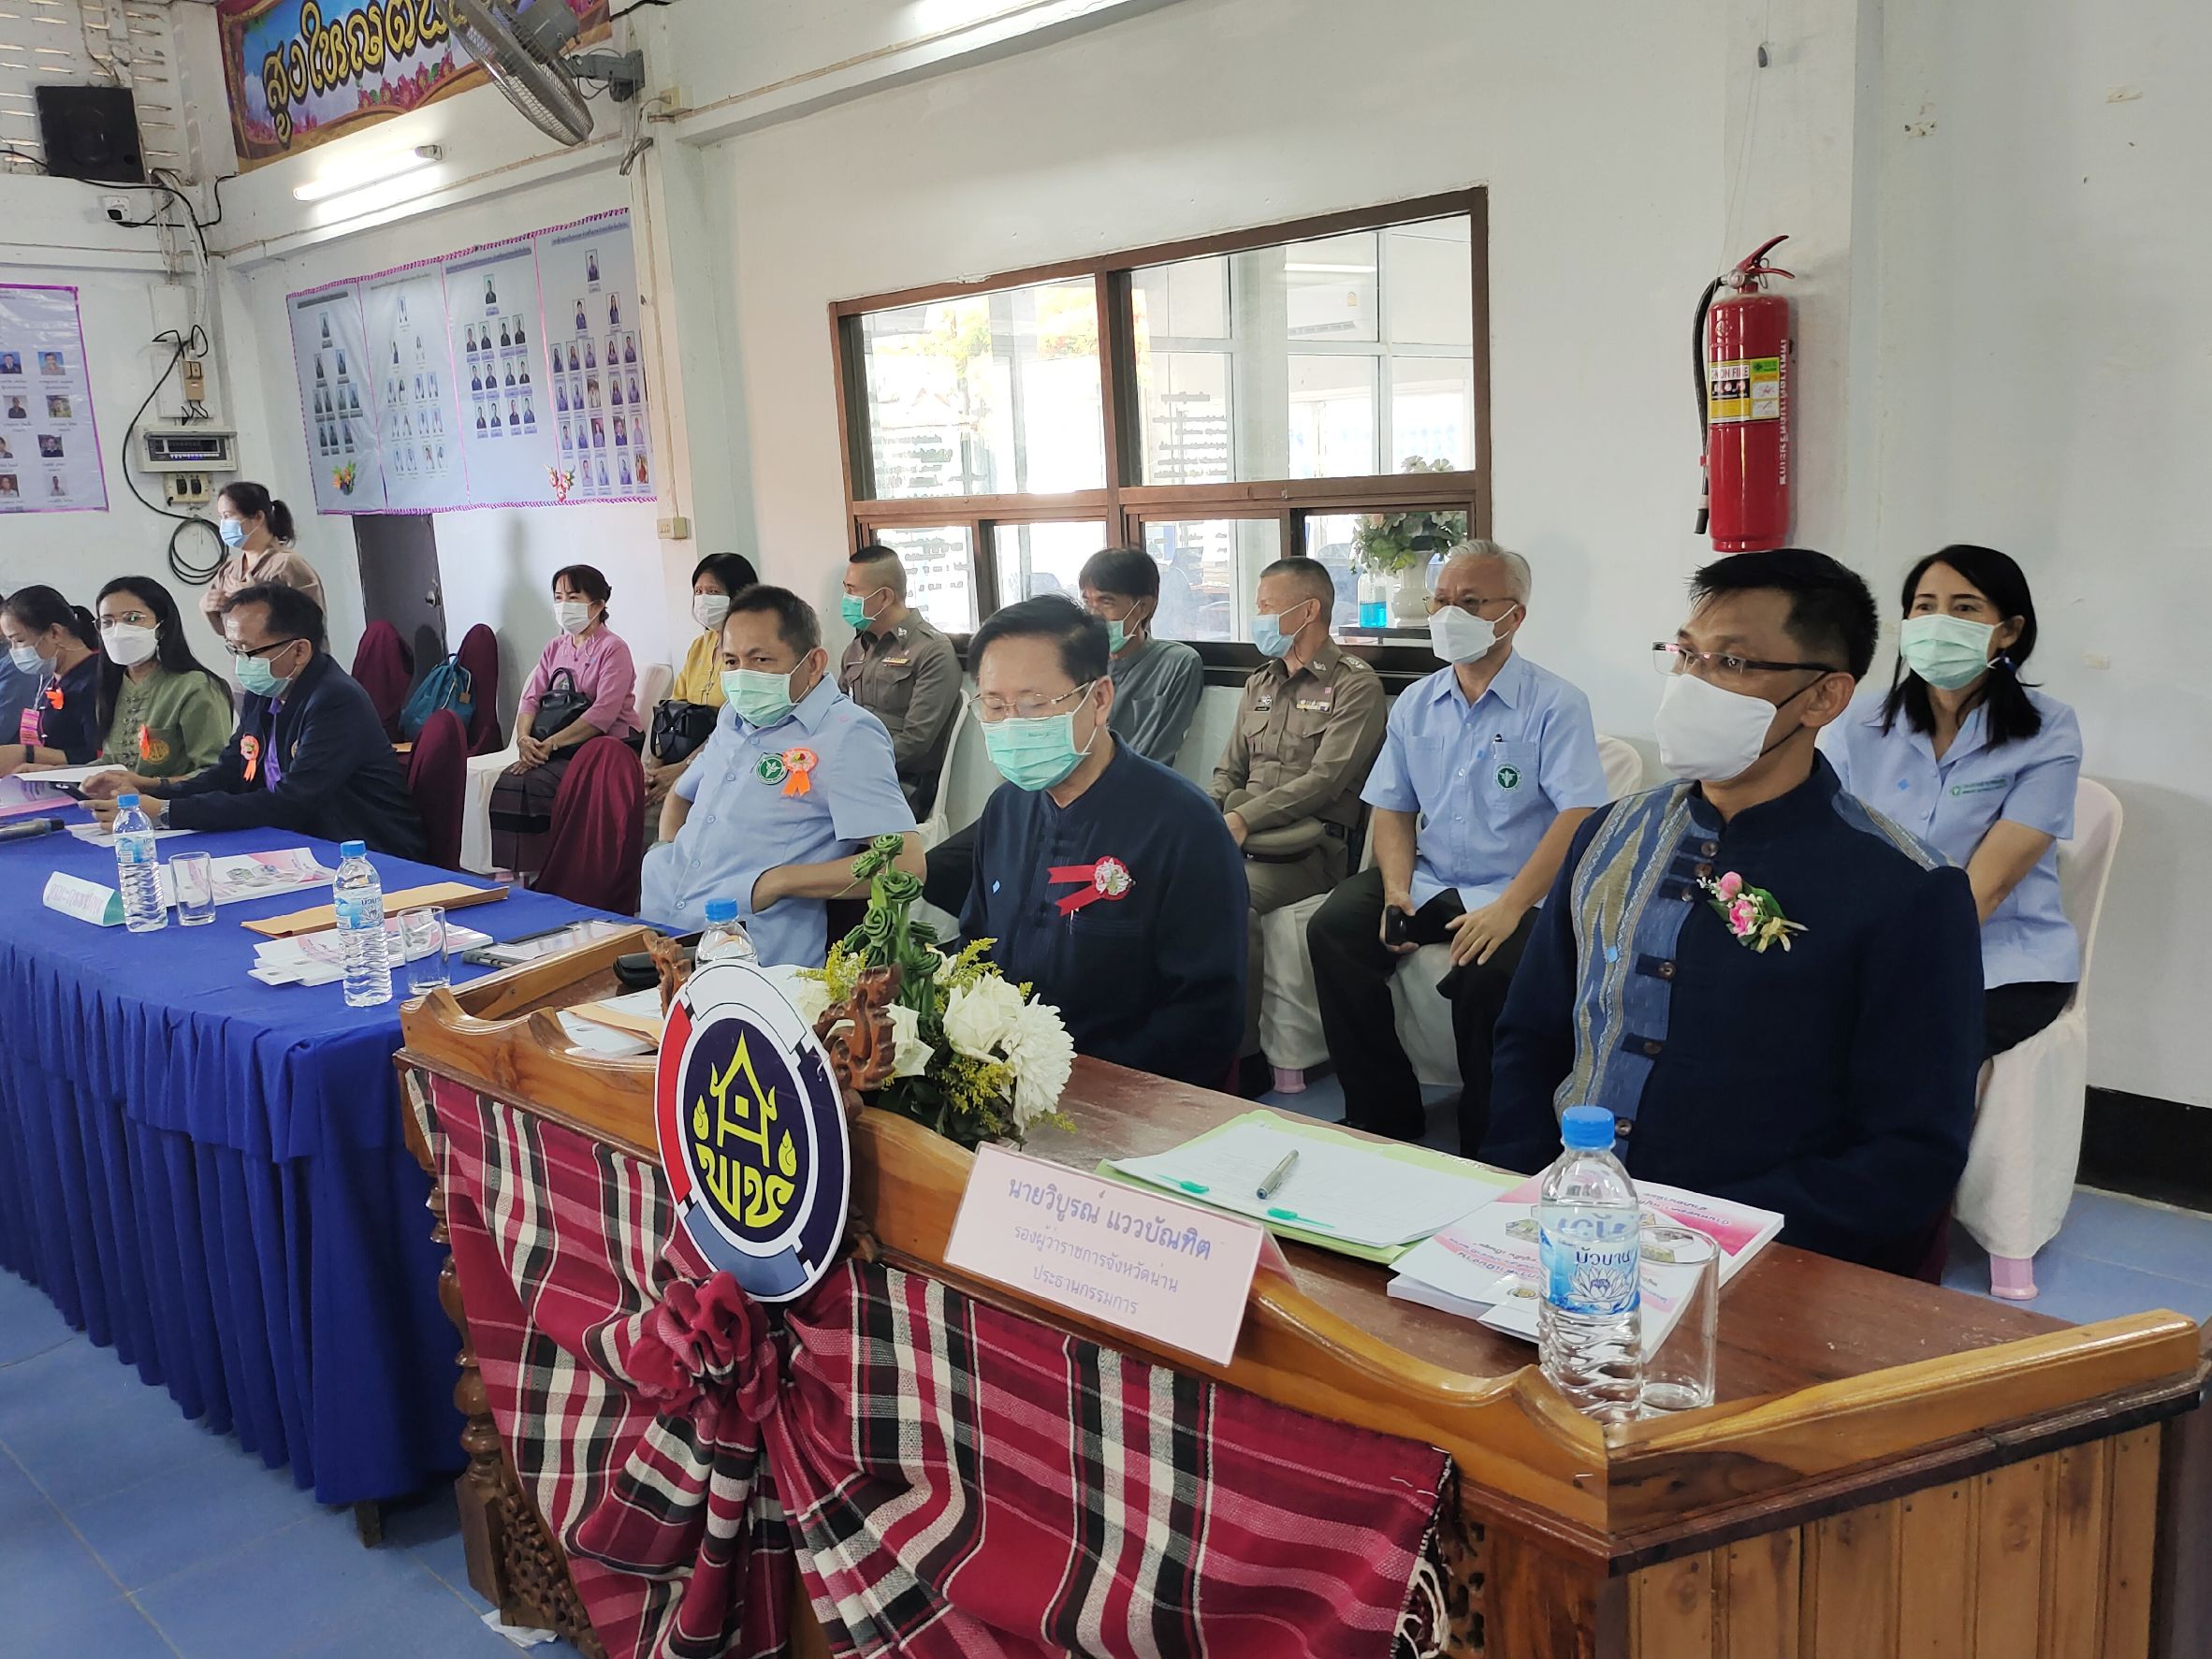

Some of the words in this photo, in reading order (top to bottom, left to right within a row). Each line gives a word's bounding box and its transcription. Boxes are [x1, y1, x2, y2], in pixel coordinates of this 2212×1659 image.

[1014, 1224, 1179, 1293] รองผู้ว่าราชการจังหวัดน่าน
[1106, 1207, 1212, 1260] แววบัณฑิต
[1032, 1265, 1139, 1315] ประธานกรรมการ
